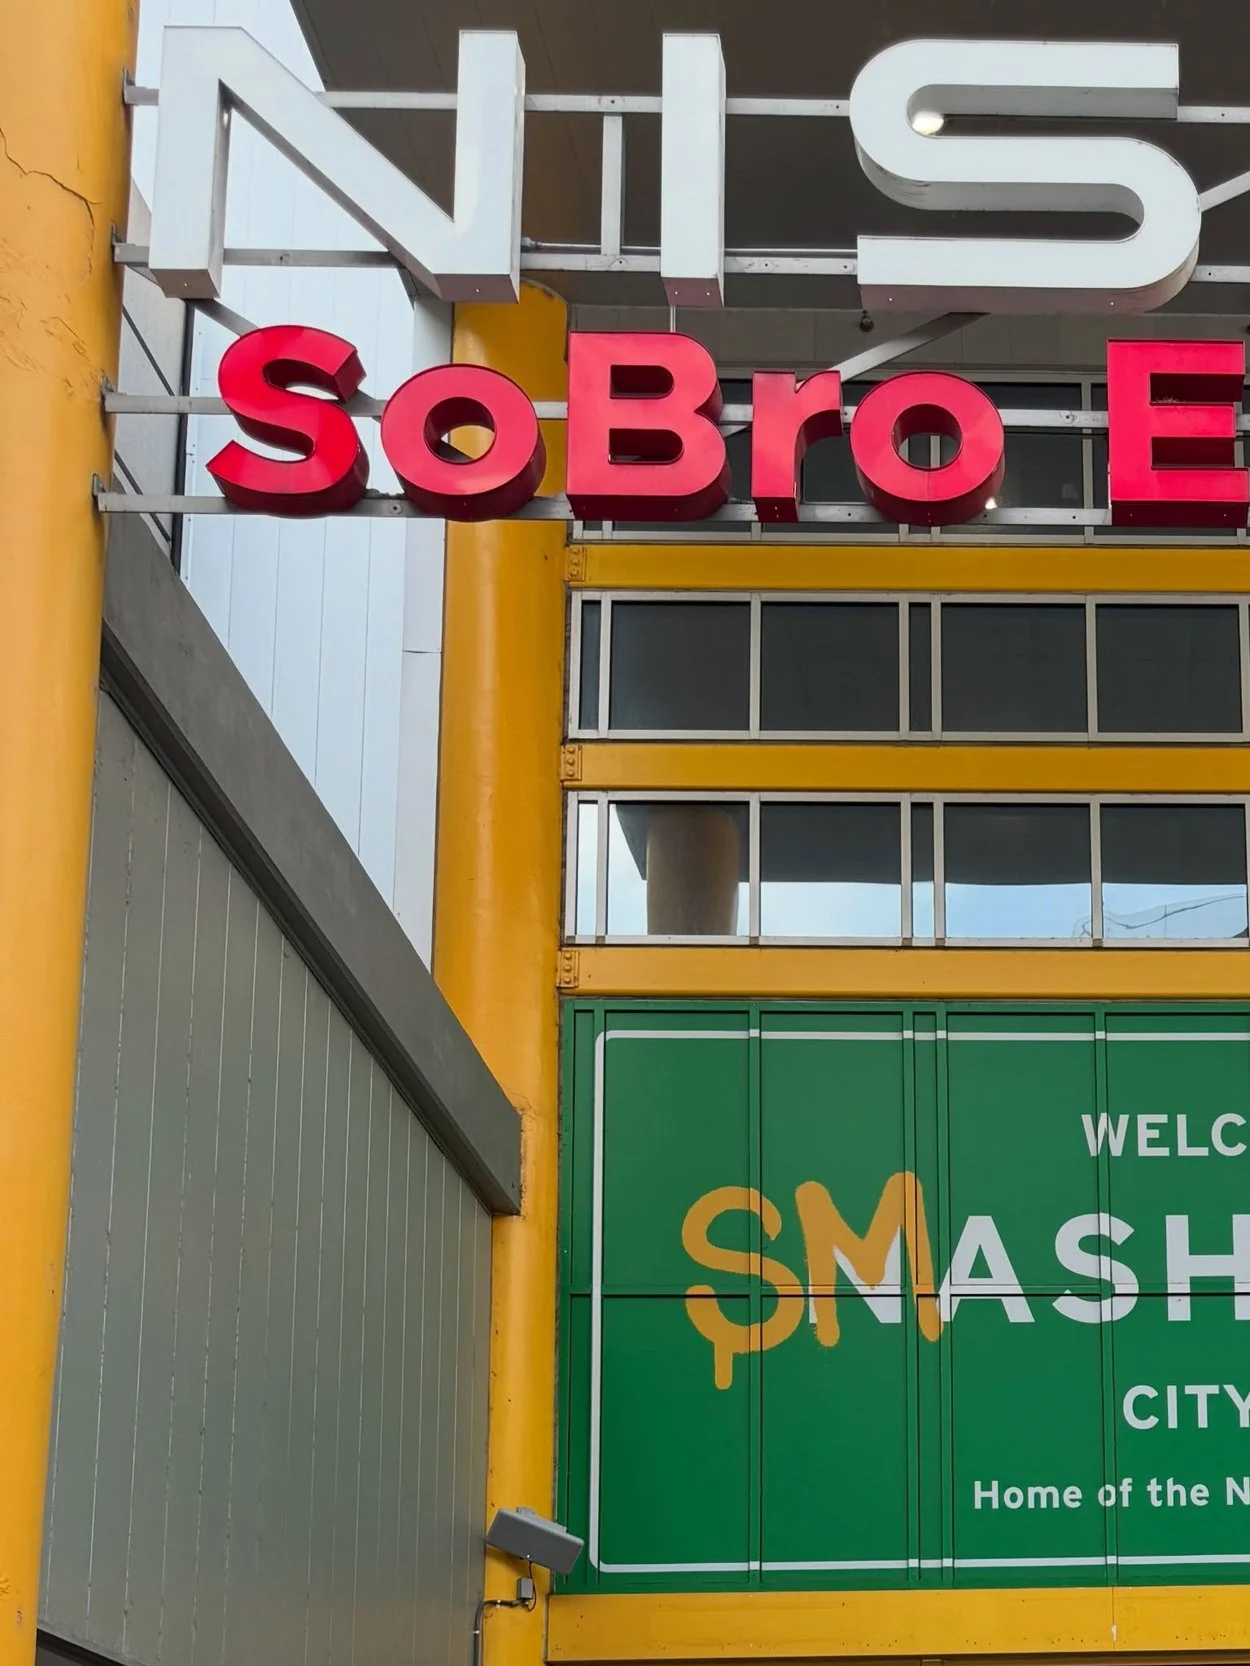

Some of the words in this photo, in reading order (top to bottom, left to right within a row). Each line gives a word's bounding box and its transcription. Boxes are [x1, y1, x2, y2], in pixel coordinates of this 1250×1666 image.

[206, 325, 1004, 525] SoBro
[973, 1480, 1083, 1510] Home
[1097, 1477, 1133, 1508] of
[1146, 1476, 1210, 1508] the
